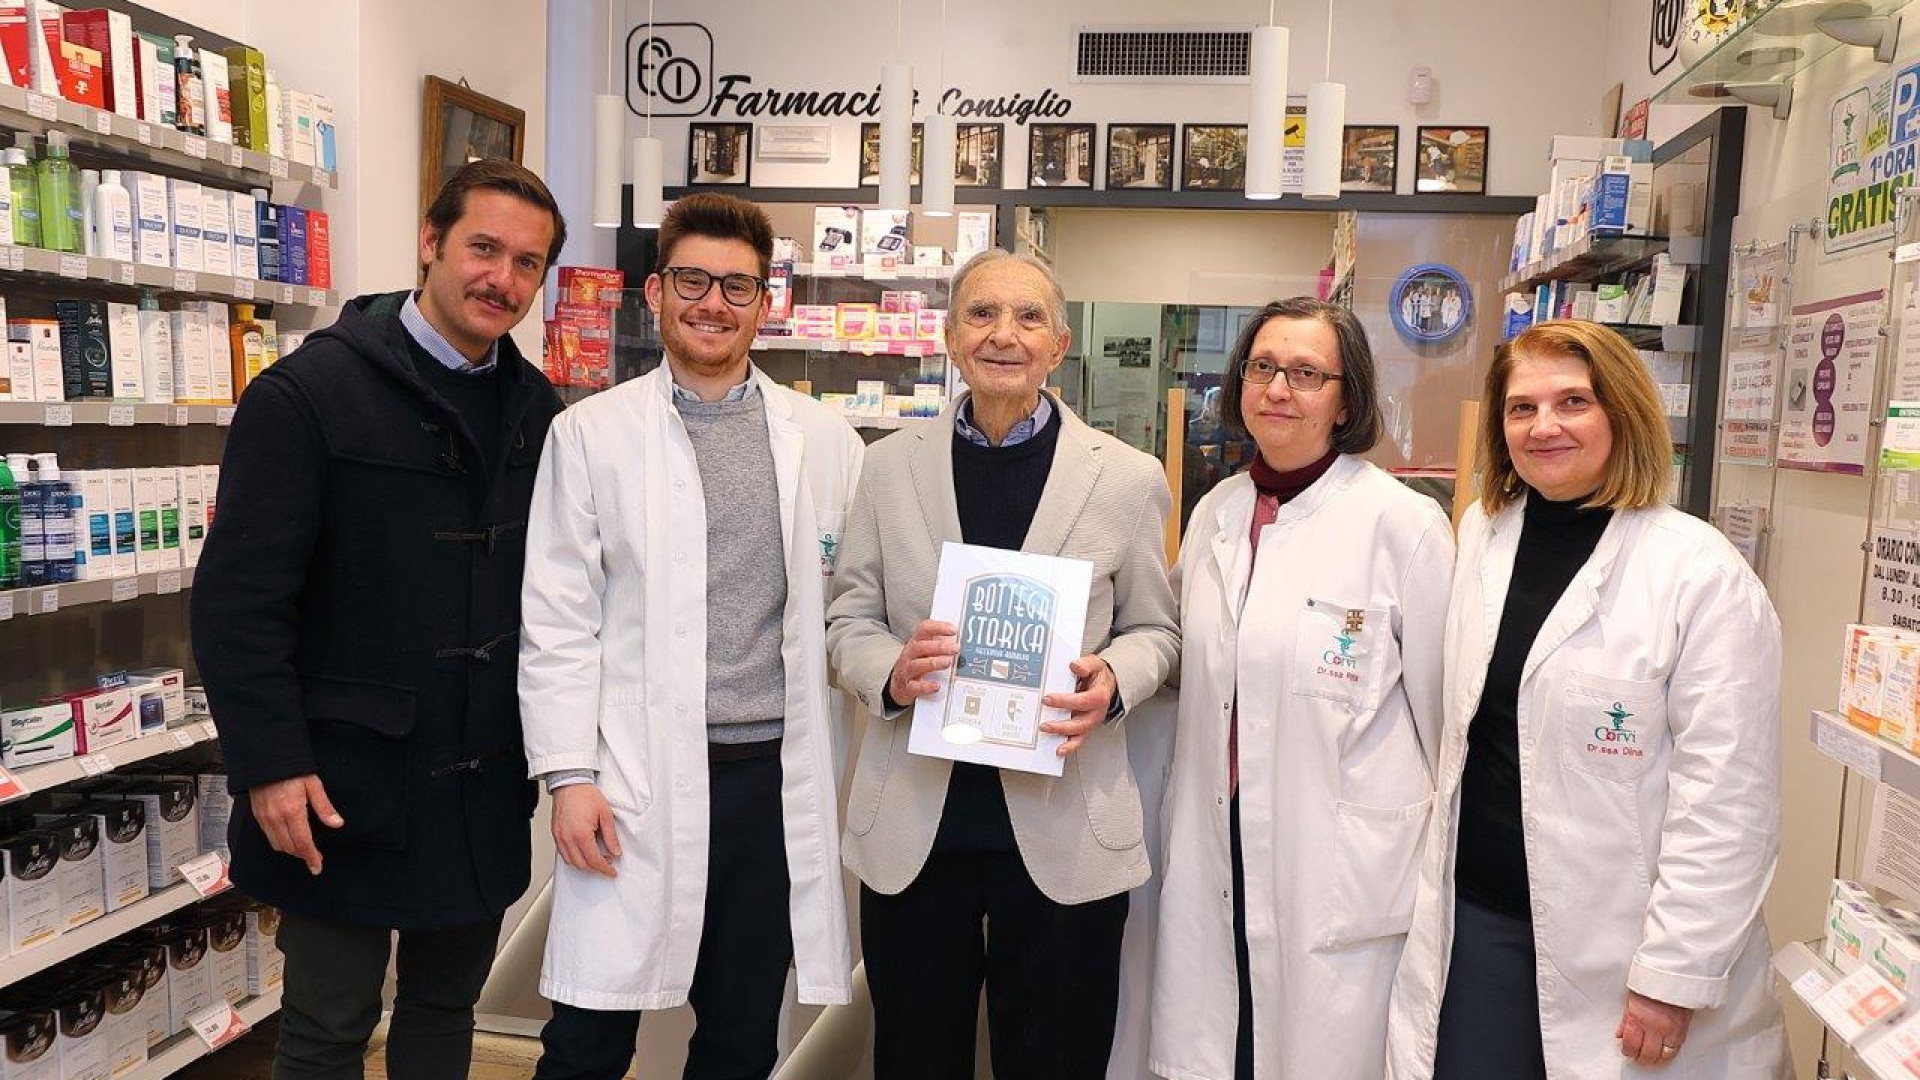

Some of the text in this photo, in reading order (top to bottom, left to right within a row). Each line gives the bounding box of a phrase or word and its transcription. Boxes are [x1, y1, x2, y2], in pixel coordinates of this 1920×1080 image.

[937, 88, 1072, 125] Consiglio
[1884, 143, 1915, 179] ORA
[1877, 537, 1903, 562] ORARIO
[972, 582, 1049, 623] BOTTEGA
[966, 615, 1045, 654] STORICA
[1323, 650, 1357, 669] Corvi
[1595, 725, 1636, 743] Corvi
